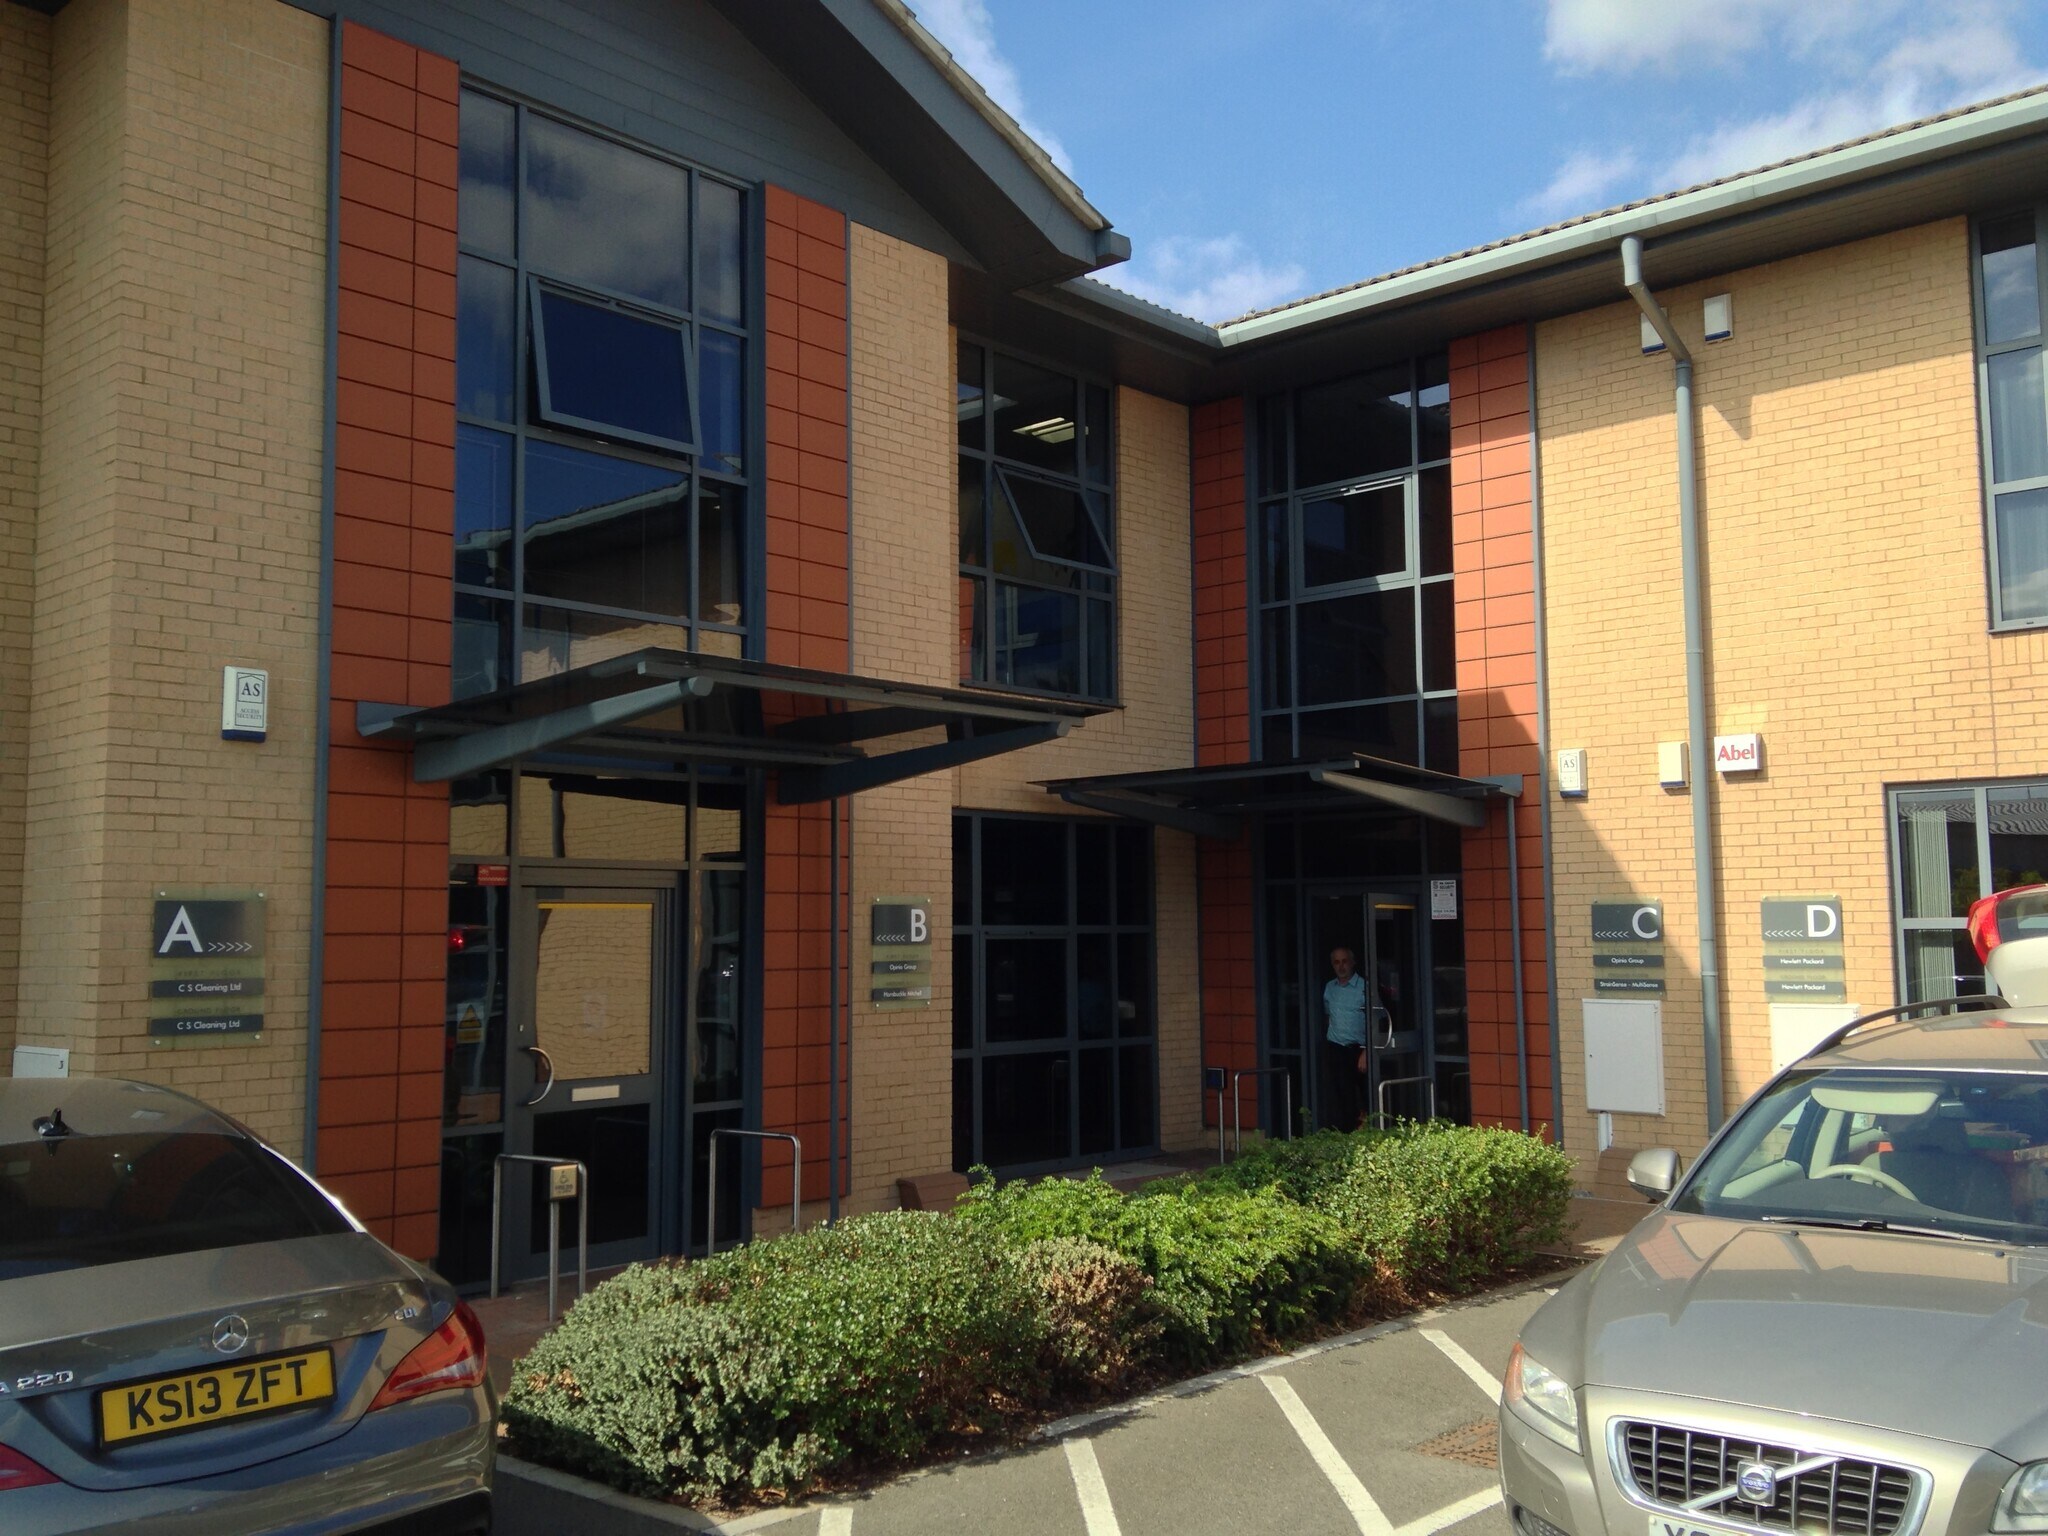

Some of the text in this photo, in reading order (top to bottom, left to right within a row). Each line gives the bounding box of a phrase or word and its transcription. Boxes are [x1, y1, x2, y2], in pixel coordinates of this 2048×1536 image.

[241, 682, 261, 697] AS
[1717, 743, 1755, 761] Abel
[1563, 759, 1575, 768] AS
[158, 904, 203, 953] A
[910, 908, 927, 942] B
[1632, 906, 1658, 939] C
[1806, 904, 1837, 938] D
[1628, 957, 1645, 965] Group
[178, 982, 242, 993] C S Cleaning Ltd
[177, 1020, 240, 1030] C S Cleaning Ltd
[128, 1358, 308, 1431] KS13 ZFT
[1741, 1479, 1770, 1489] VOLVO
